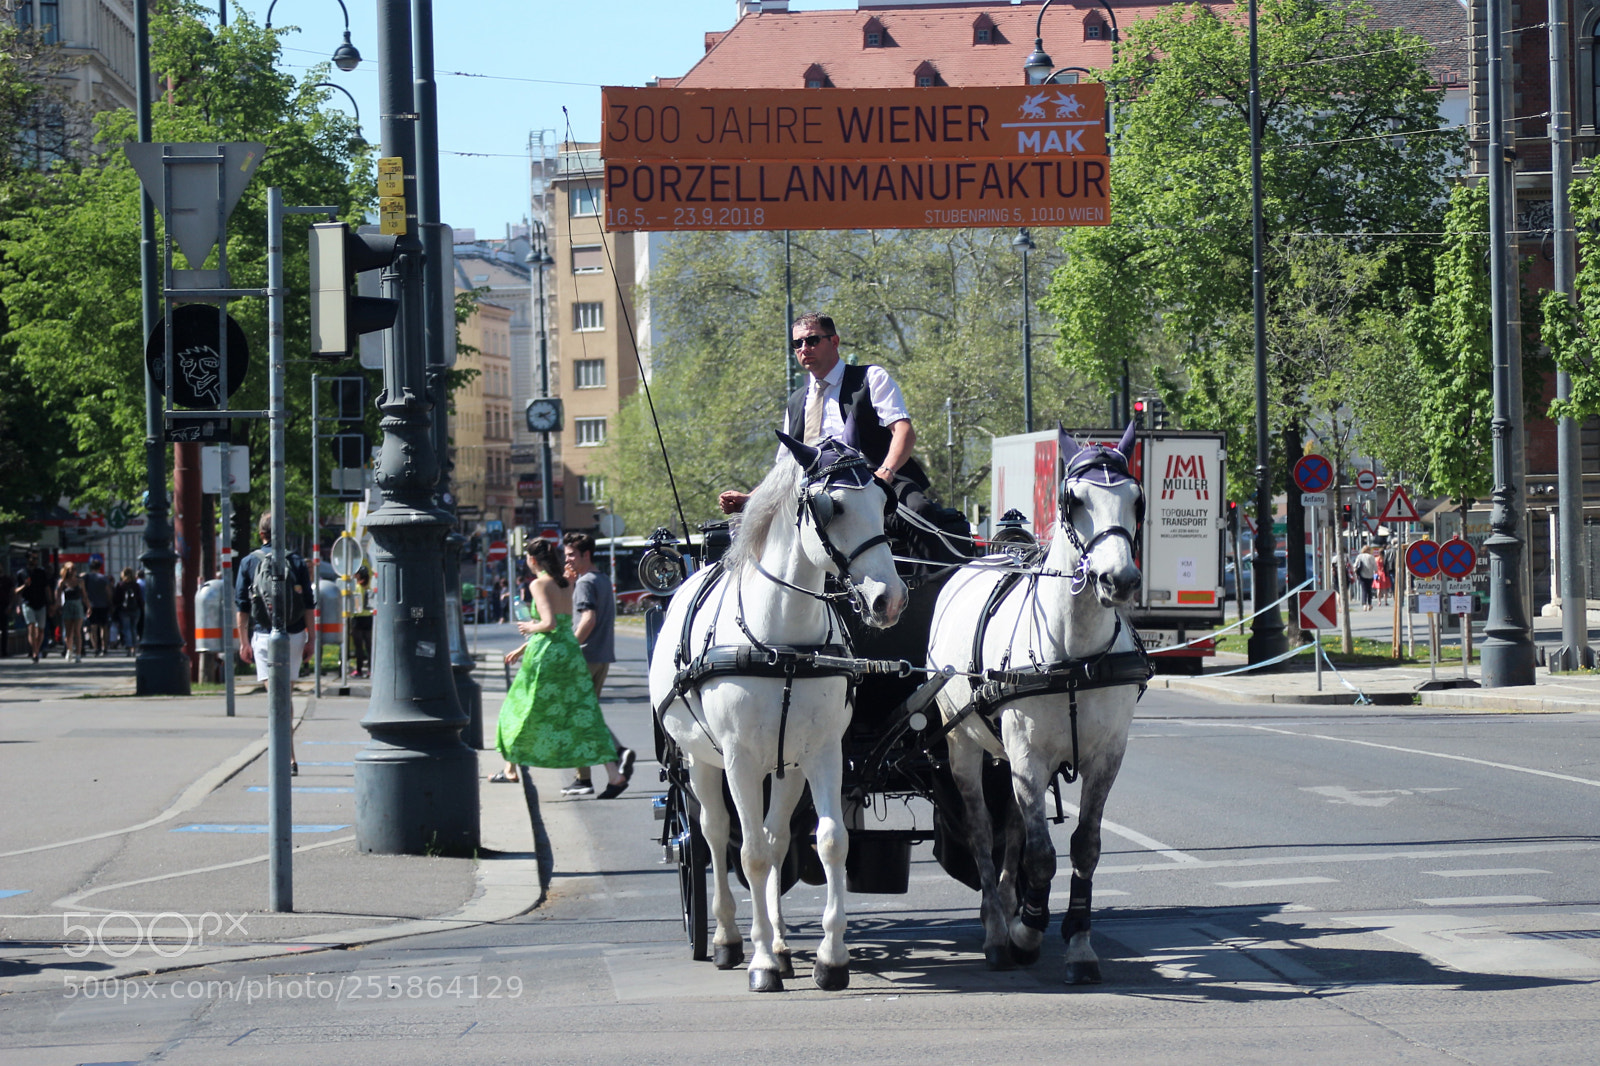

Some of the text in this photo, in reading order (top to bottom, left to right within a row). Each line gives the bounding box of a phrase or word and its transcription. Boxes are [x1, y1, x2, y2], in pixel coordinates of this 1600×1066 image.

[608, 104, 990, 144] 300 JAHRE WIENER
[1017, 129, 1086, 153] MAK
[607, 161, 1106, 202] PORZELLANMANUFAKTUR
[607, 207, 650, 226] 16.5.
[673, 207, 765, 226] 23.9.2018
[924, 206, 1104, 224] STUBENRING 5, 1010 WIEN
[1304, 495, 1325, 503] Anfang
[1161, 517, 1208, 526] TRANSPORT
[1417, 582, 1441, 591] Anfang
[1449, 582, 1471, 590] Anfang
